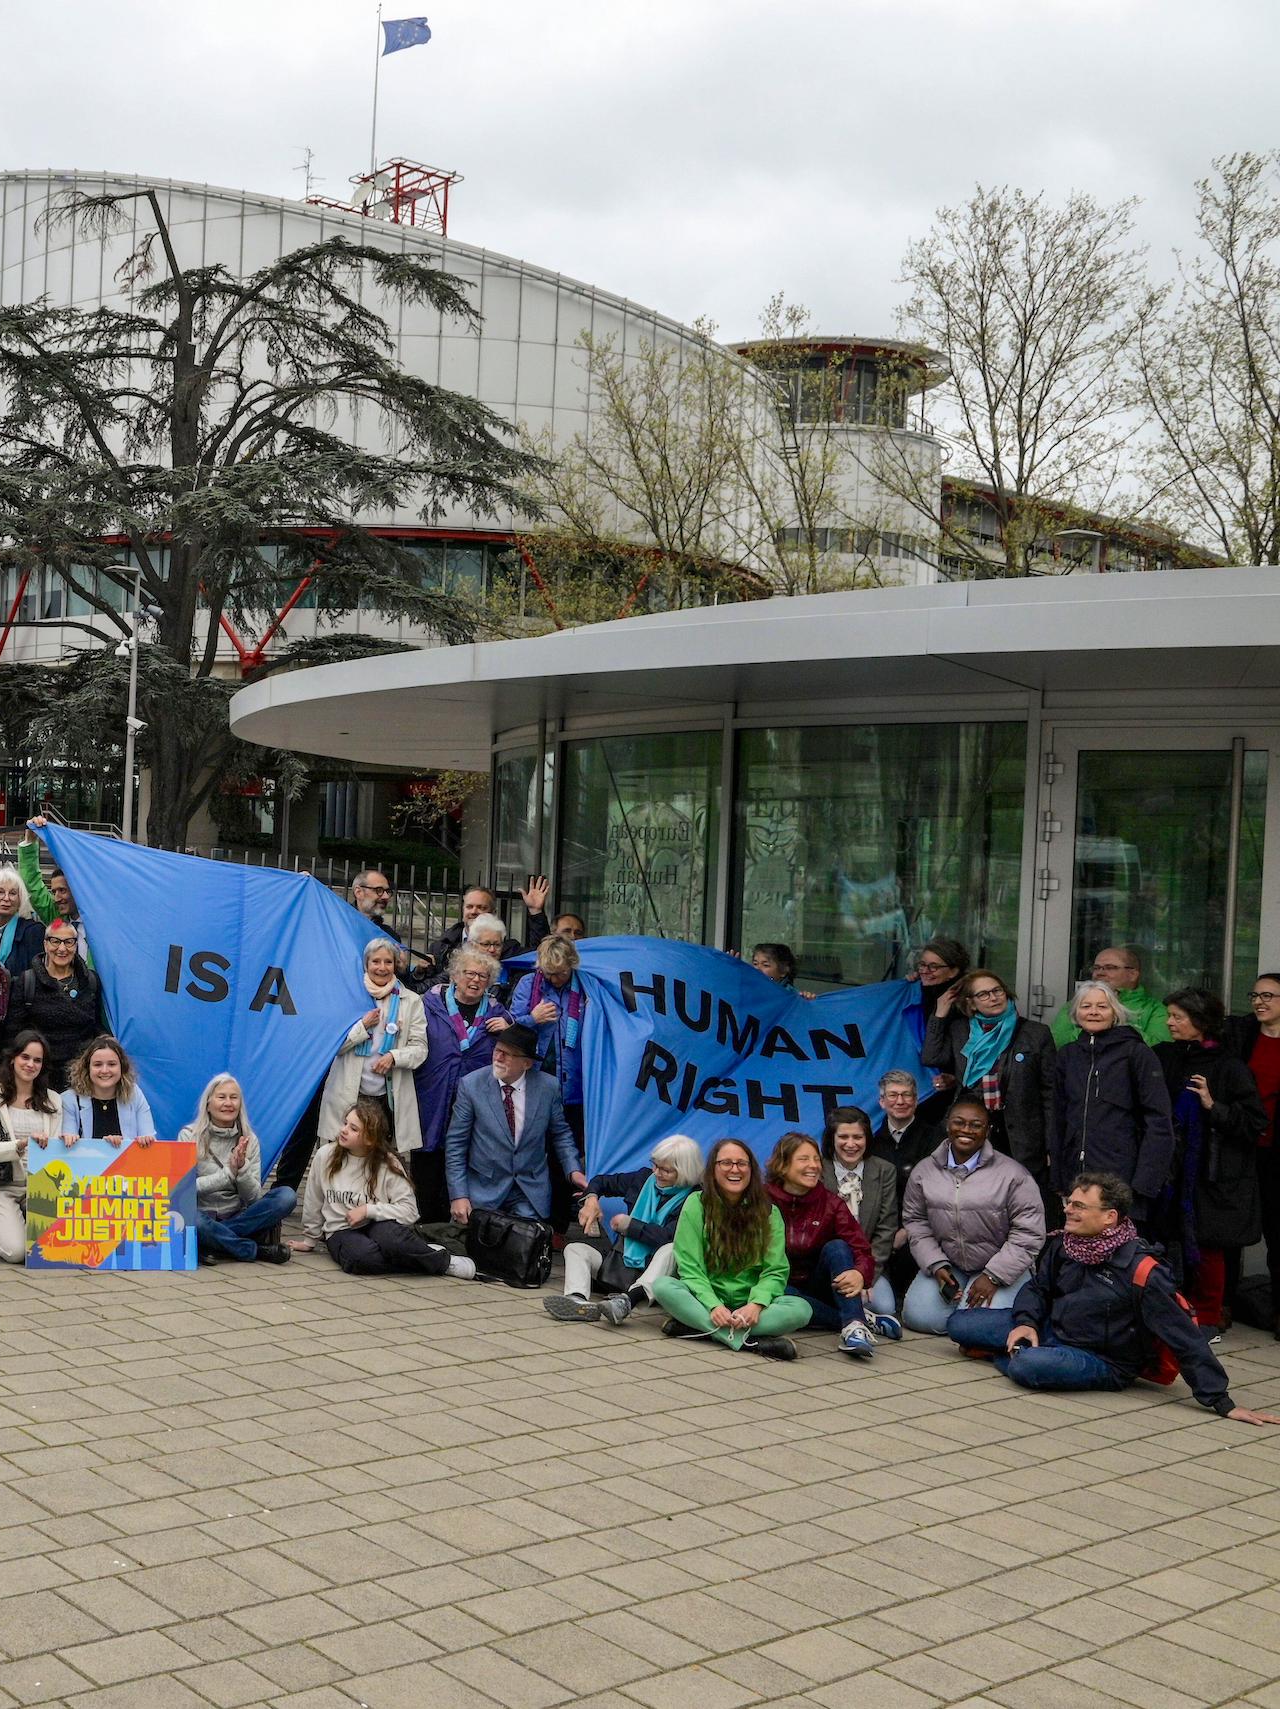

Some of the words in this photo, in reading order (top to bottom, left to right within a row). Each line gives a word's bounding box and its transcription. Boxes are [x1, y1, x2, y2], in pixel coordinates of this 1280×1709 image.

[165, 944, 231, 1003] IS
[249, 966, 298, 1016] A
[620, 971, 867, 1062] HUMAN
[635, 1040, 854, 1123] RIGHT
[56, 1219, 171, 1242] JUSTICE
[57, 1197, 172, 1220] CLIMATE
